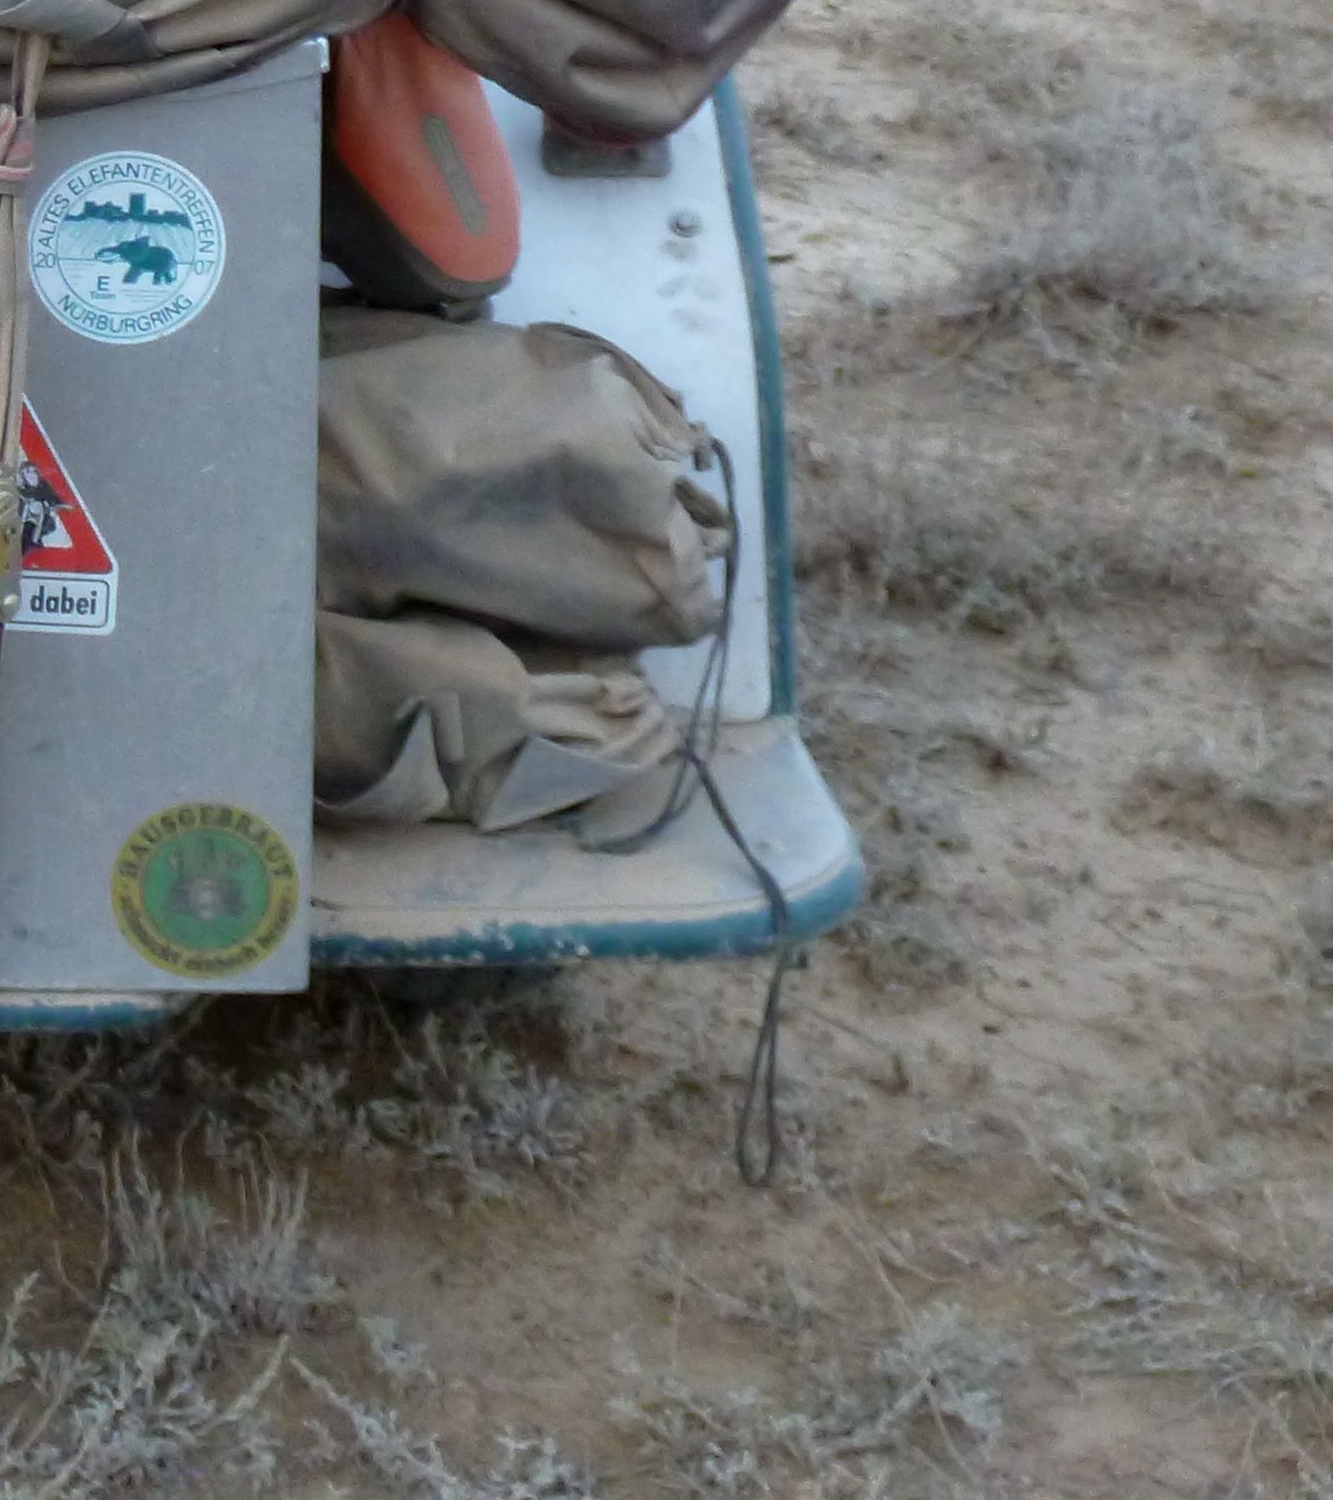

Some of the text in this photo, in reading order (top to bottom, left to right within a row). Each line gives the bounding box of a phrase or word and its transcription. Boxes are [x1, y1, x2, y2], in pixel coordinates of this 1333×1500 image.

[38, 162, 216, 252] ALTES ELEFANTENTREFFEN
[35, 253, 57, 269] 20
[97, 276, 110, 291] E
[29, 585, 98, 616] dabei
